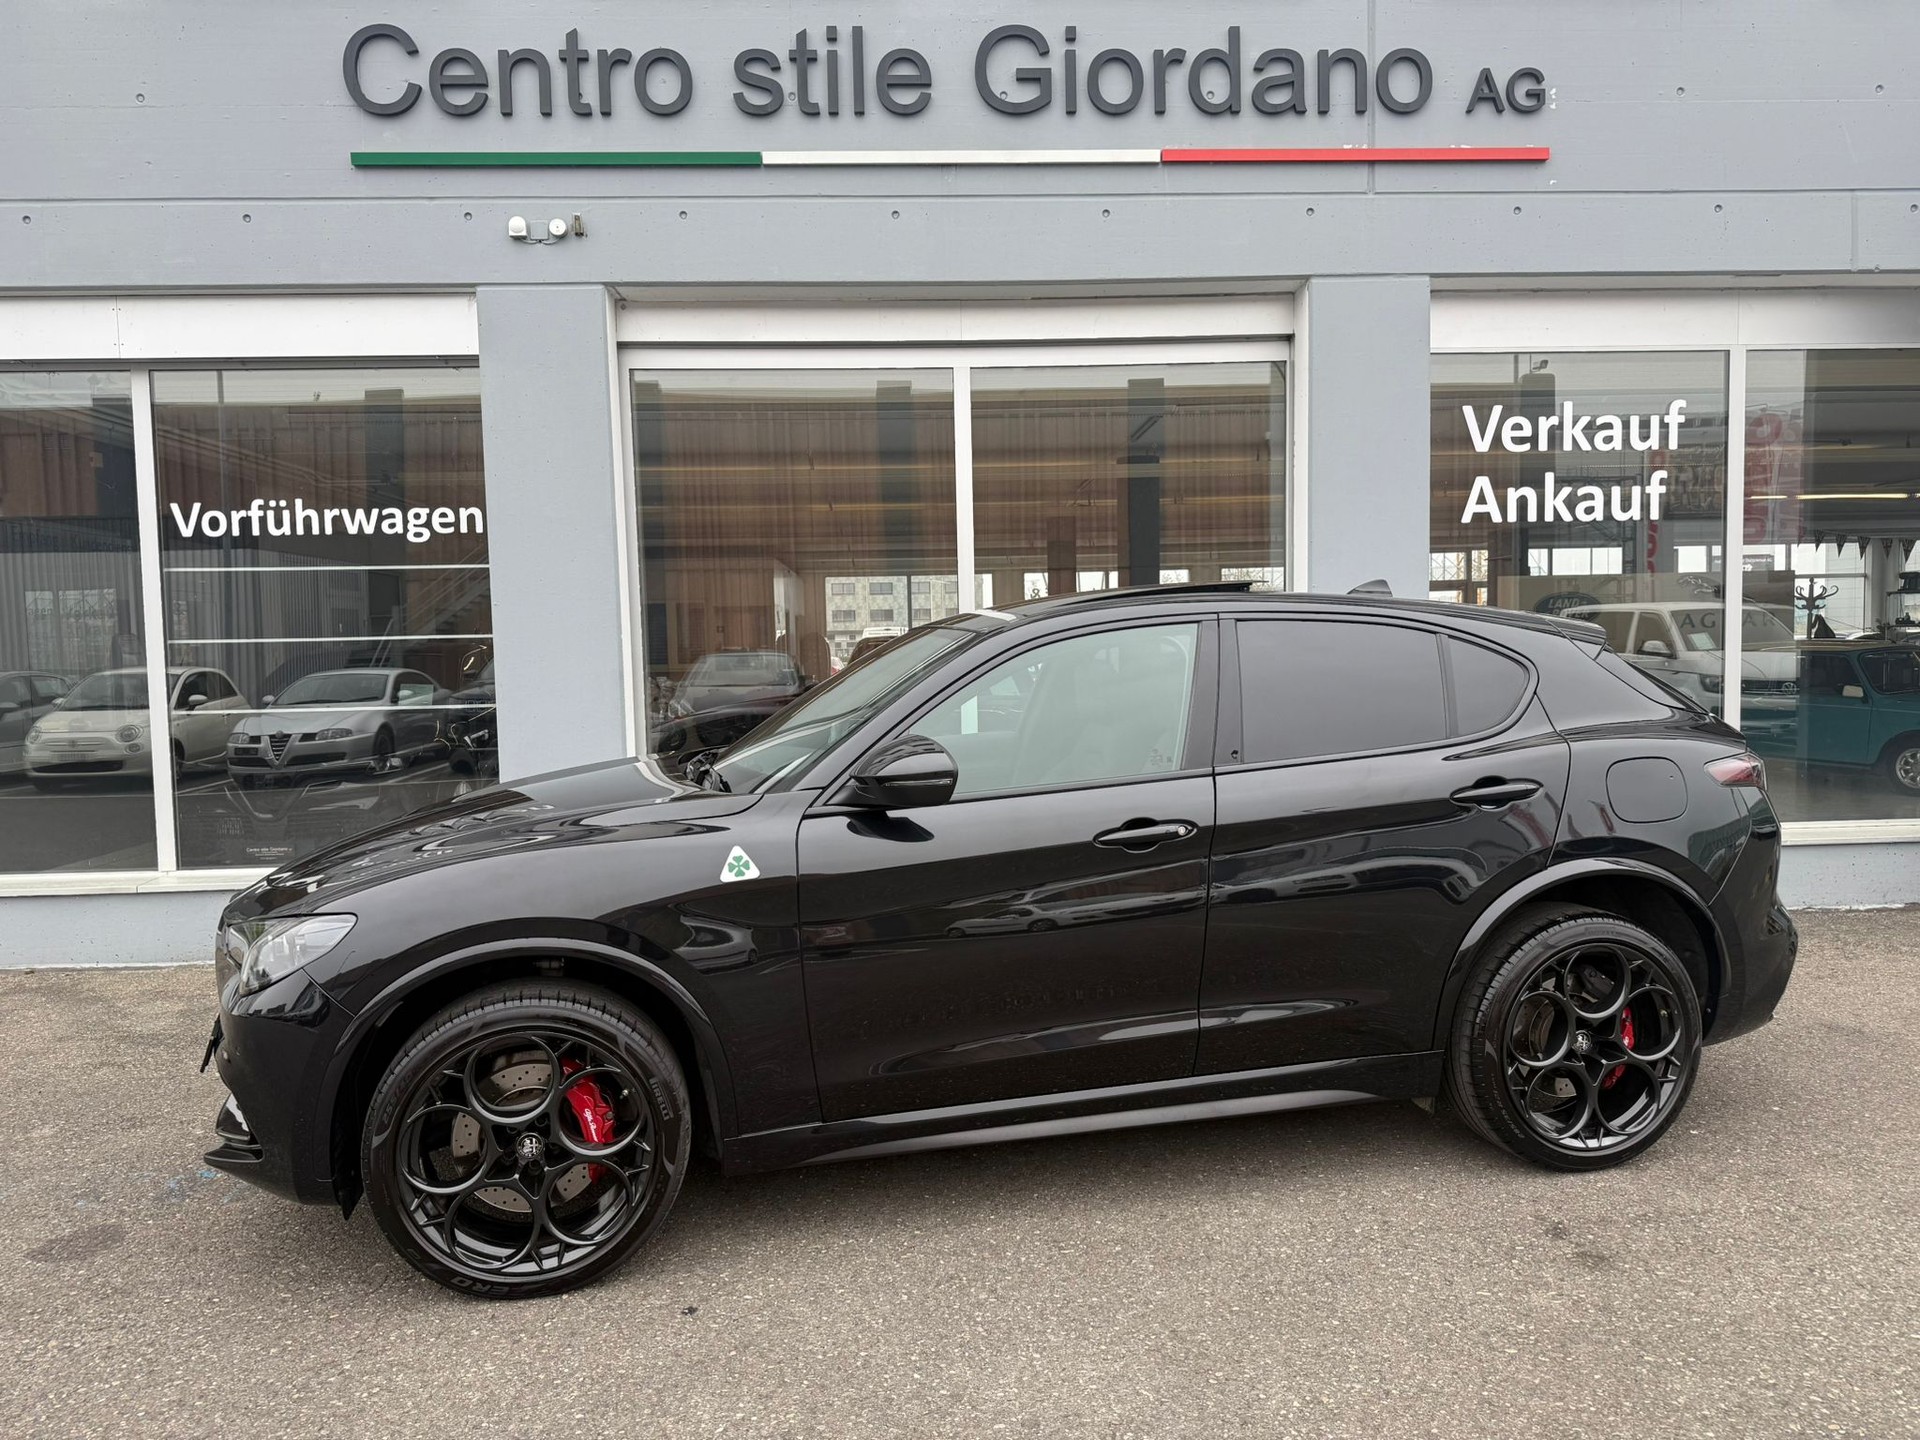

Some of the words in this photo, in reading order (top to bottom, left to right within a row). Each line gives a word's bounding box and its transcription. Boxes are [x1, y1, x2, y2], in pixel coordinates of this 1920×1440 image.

[343, 23, 693, 117] Centro
[732, 25, 932, 117] stile
[974, 24, 1433, 116] Giordano
[1465, 67, 1547, 114] AG
[1462, 400, 1687, 453] Verkauf
[170, 499, 484, 542] Vorführwagen
[1460, 470, 1668, 523] Ankauf
[1548, 598, 1580, 608] LAND
[649, 1078, 674, 1121] PIRELLI
